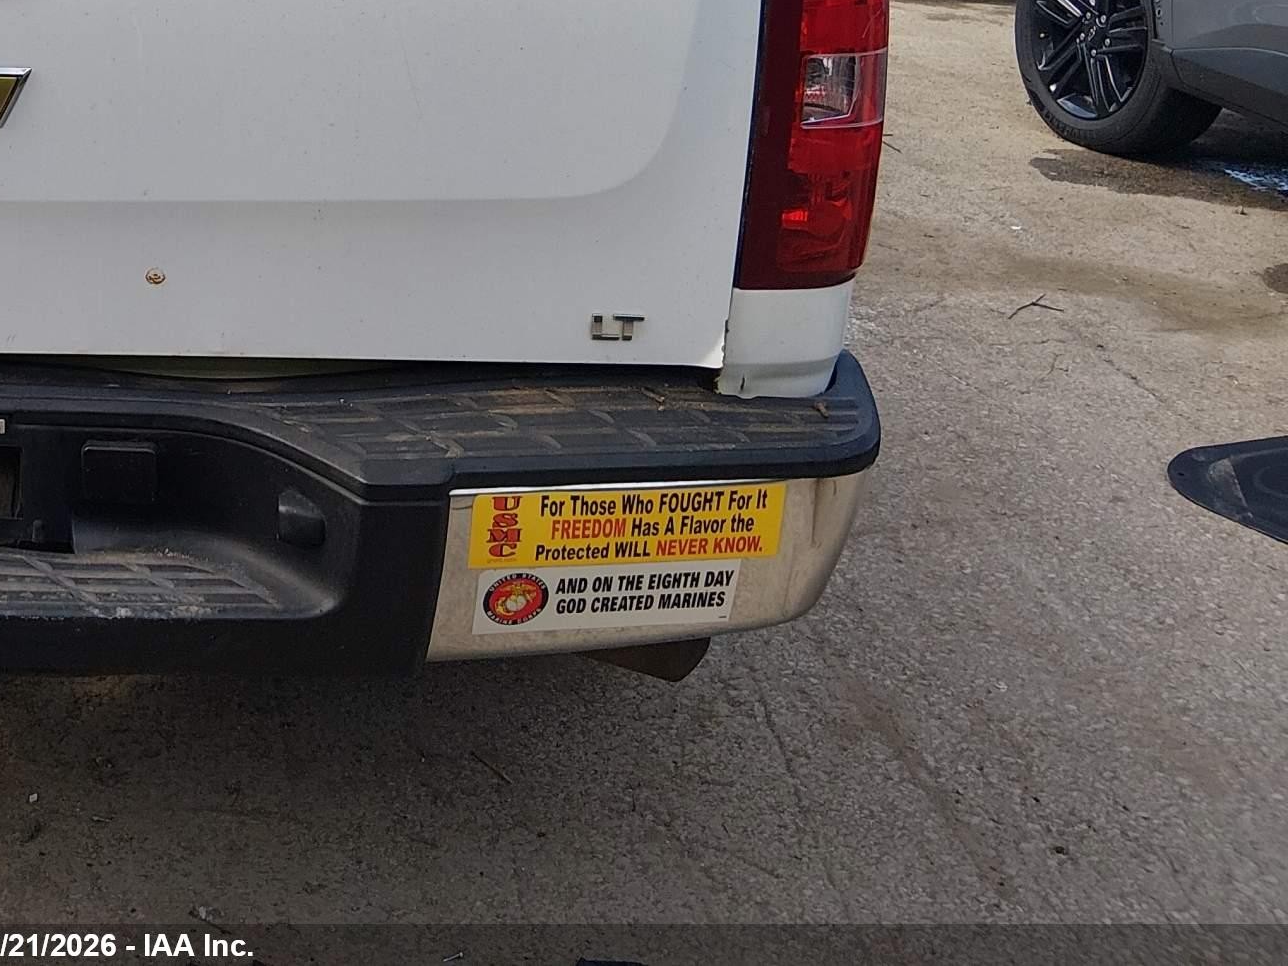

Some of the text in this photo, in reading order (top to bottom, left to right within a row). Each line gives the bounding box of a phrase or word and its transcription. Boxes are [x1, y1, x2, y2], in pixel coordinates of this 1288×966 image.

[591, 313, 645, 341] LT
[540, 488, 768, 517] For Those Who FOUGHT For It
[486, 496, 523, 557] USMC
[551, 513, 755, 540] FREEDOM Has A Flavor the
[535, 536, 763, 561] Protected WILL NEVER KNOW.
[555, 570, 734, 594] AND ON THE EIGHTH DAY
[556, 591, 726, 614] GOD CREATED MARINES
